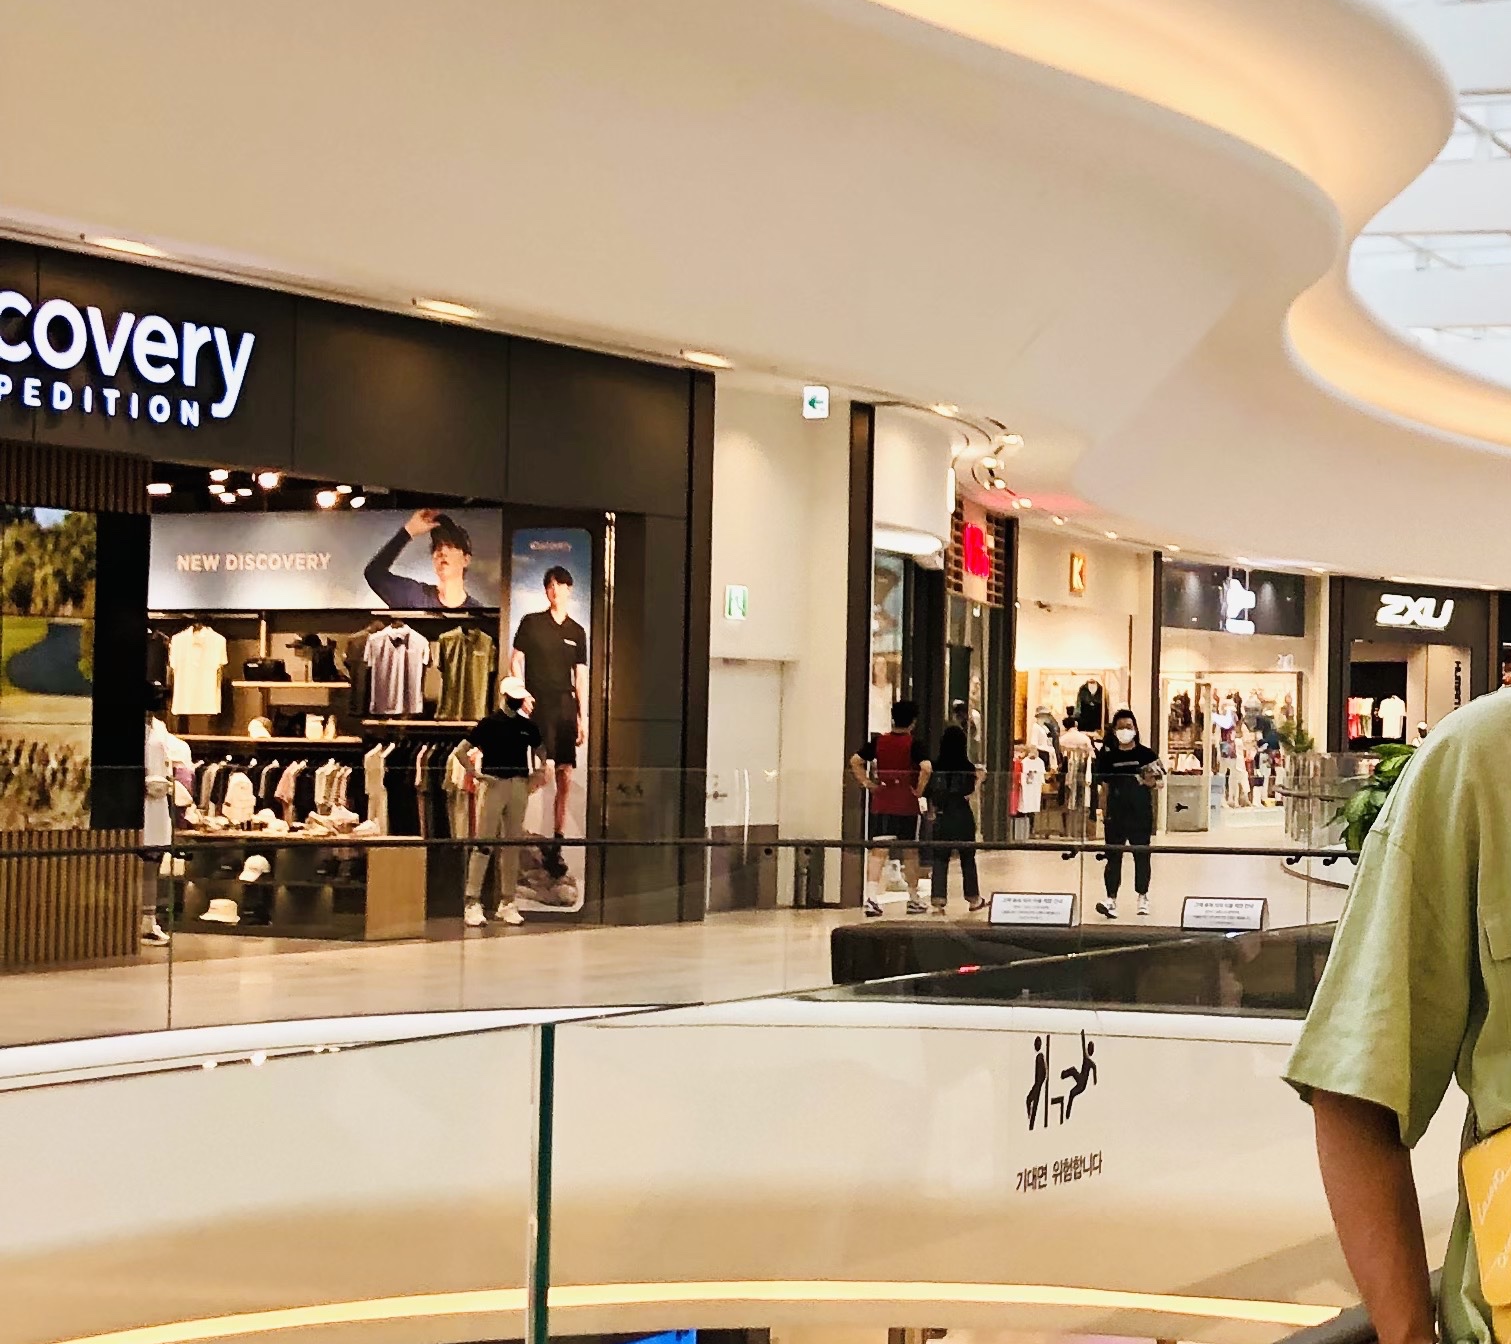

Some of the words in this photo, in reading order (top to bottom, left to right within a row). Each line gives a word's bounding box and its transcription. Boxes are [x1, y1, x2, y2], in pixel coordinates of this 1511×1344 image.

[0, 290, 256, 419] covery
[176, 553, 221, 572] NEW
[225, 552, 331, 572] DISCOVERY
[1016, 1163, 1048, 1193] 기대면
[1052, 1150, 1102, 1185] 위험합니다
